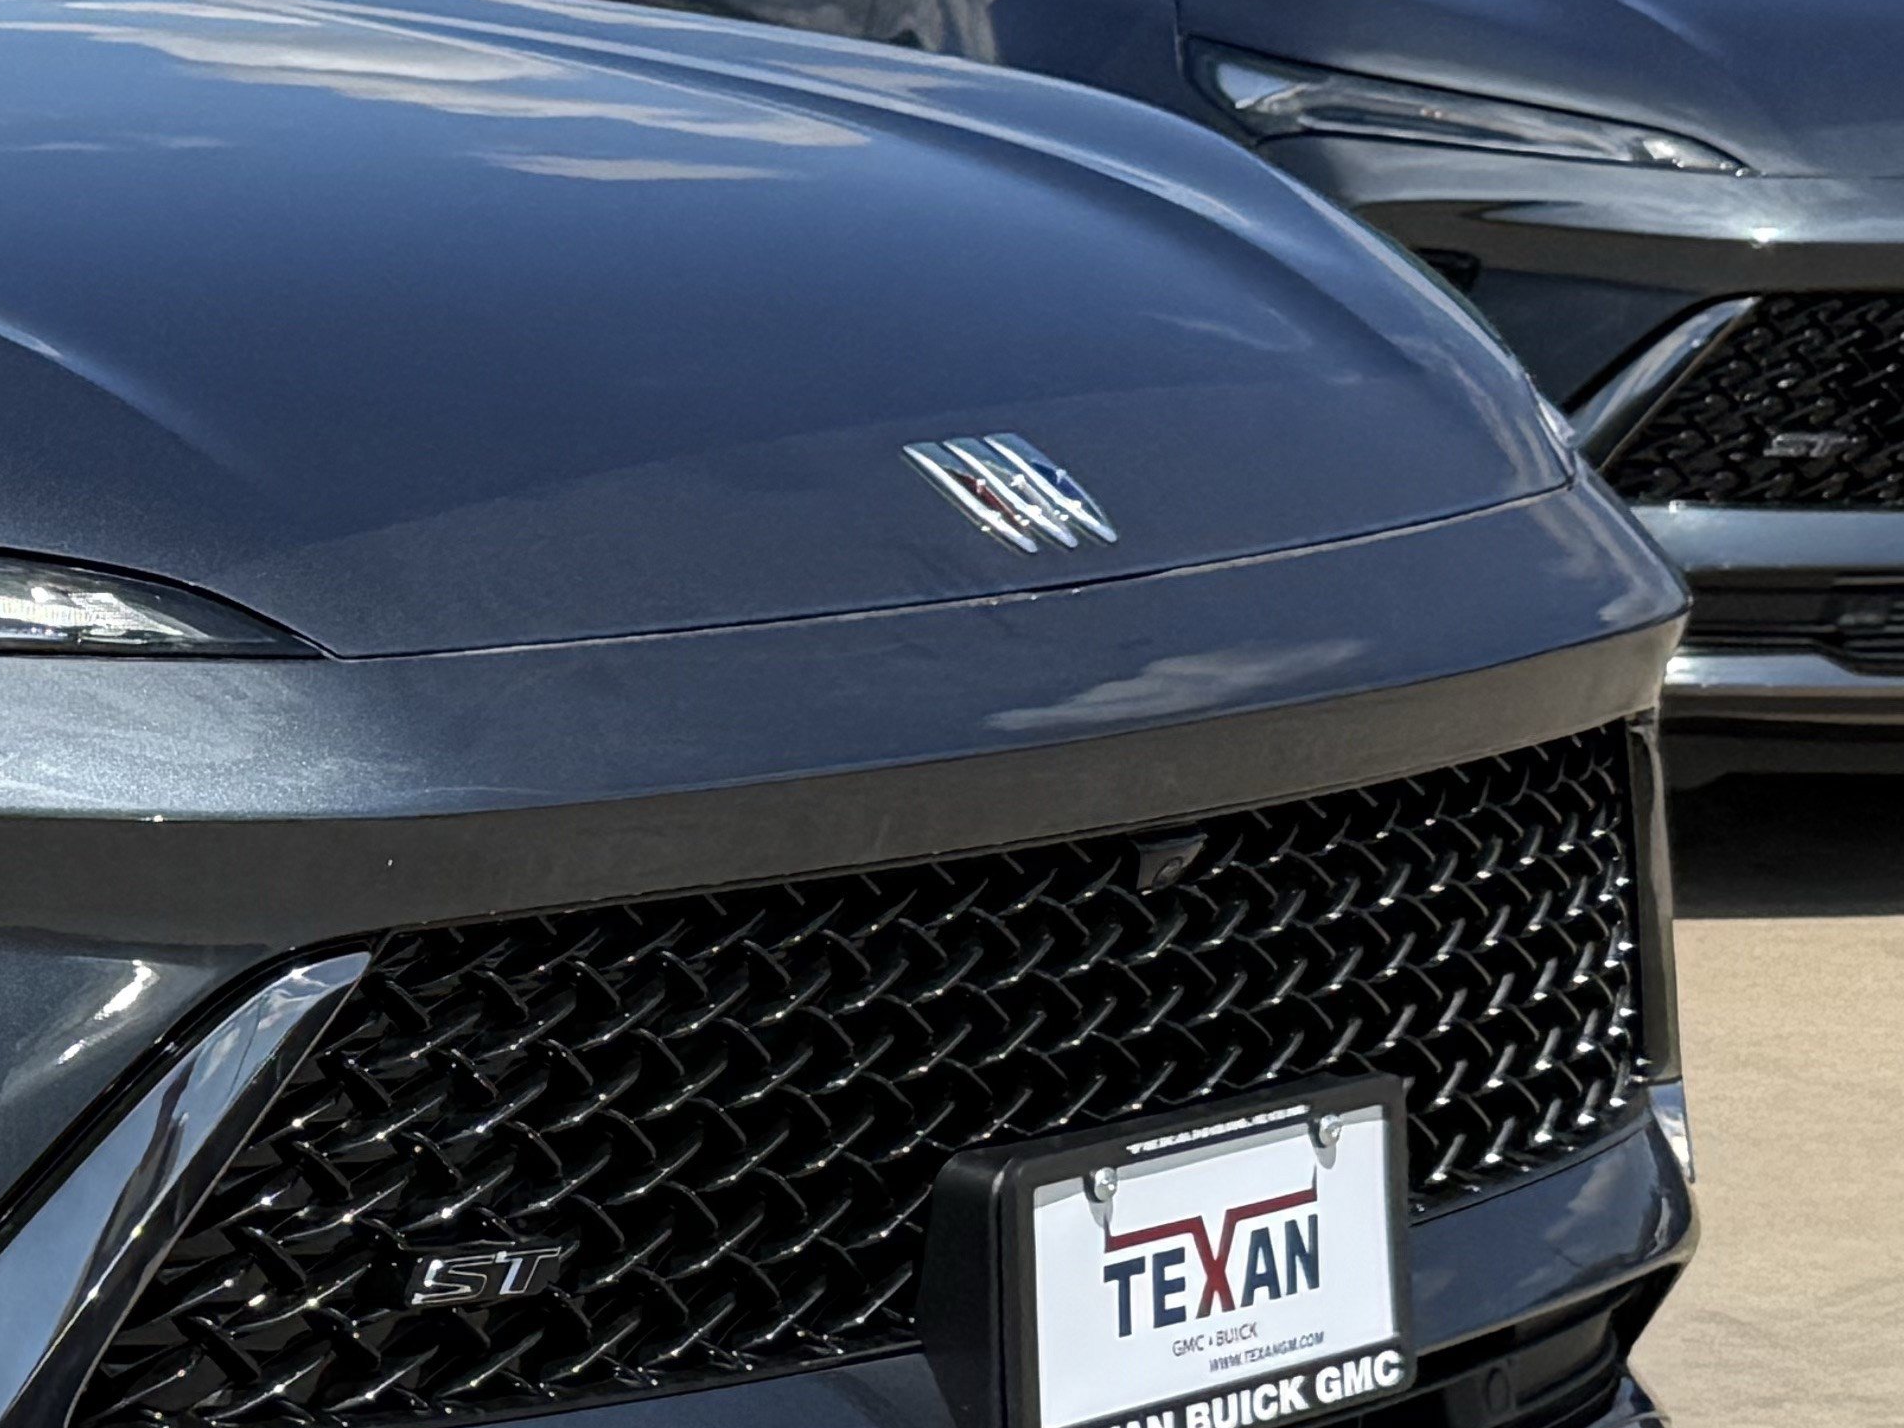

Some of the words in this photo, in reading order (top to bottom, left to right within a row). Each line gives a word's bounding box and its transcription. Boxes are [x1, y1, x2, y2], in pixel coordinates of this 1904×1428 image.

[411, 1246, 561, 1306] ST
[1102, 1188, 1320, 1338] TEXAN
[1171, 1334, 1205, 1357] GMC
[1215, 1322, 1259, 1348] BUICK
[1314, 1349, 1404, 1405] GMC
